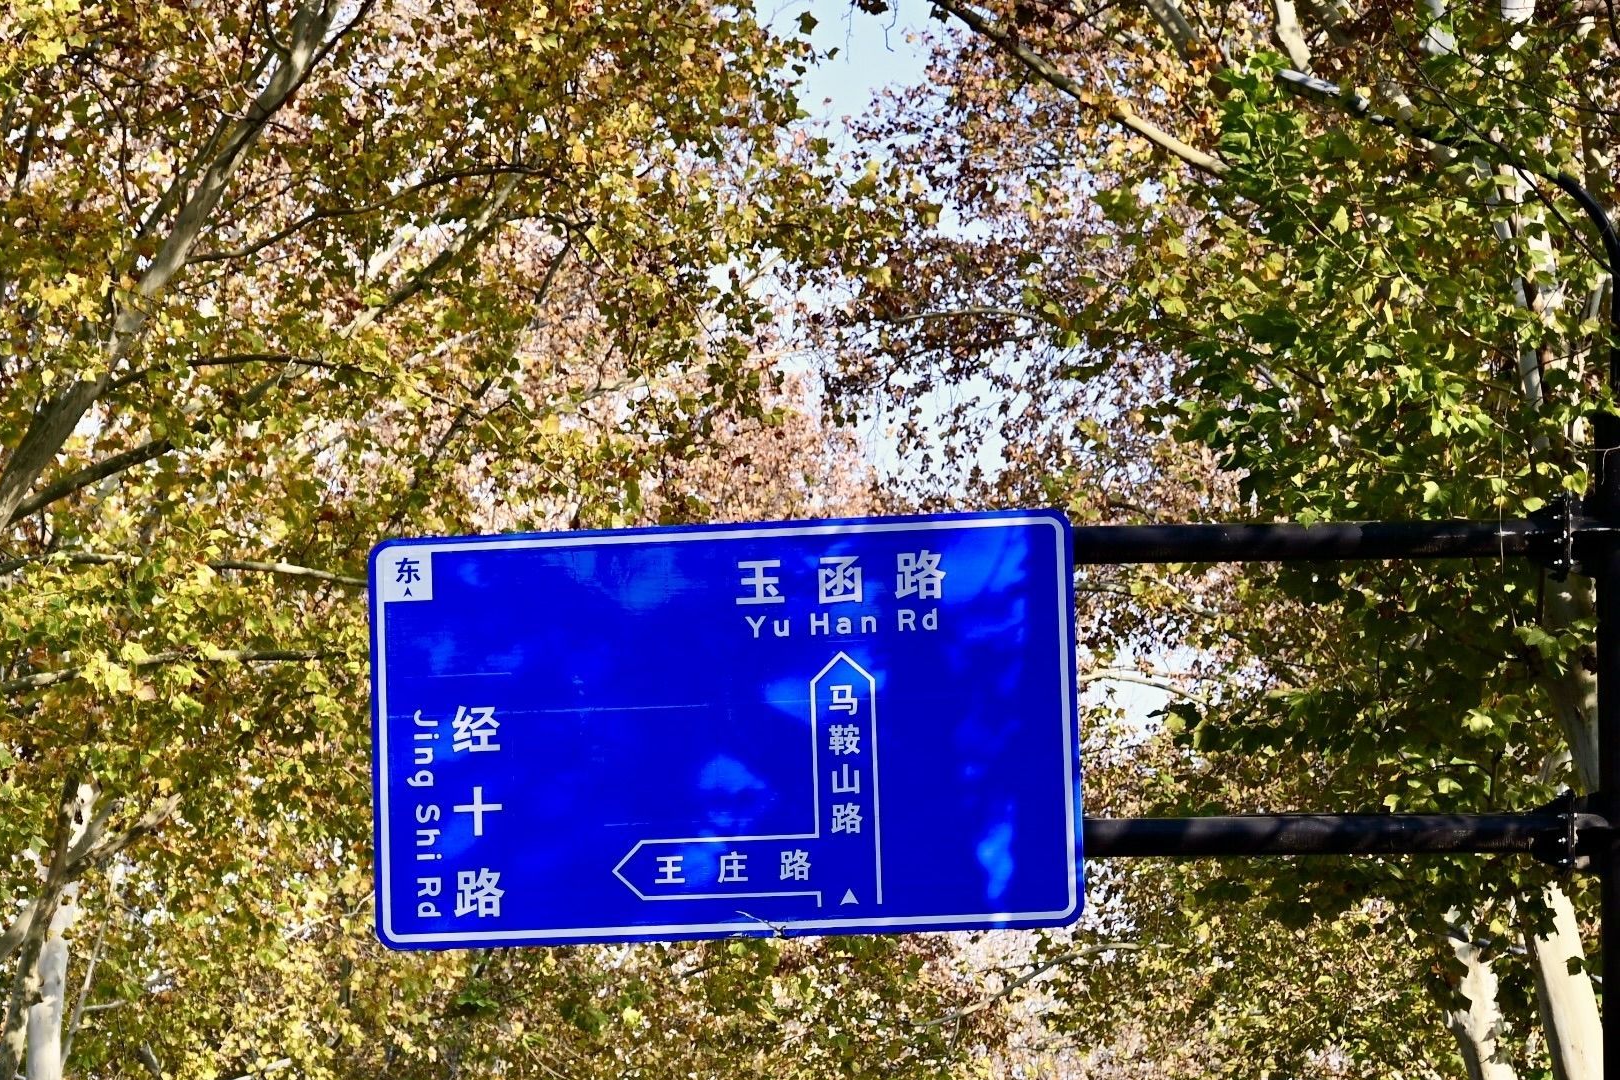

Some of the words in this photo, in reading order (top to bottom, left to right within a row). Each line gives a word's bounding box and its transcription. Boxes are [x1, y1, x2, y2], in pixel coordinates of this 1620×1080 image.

[394, 557, 421, 585] 东
[735, 549, 947, 607] 玉函路
[745, 614, 791, 639] Yu
[810, 611, 878, 635] Han
[898, 607, 939, 632] Rd
[406, 709, 440, 789] Jing
[828, 684, 863, 835] 马鞍山路
[415, 804, 442, 862] Shi
[451, 705, 506, 919] 经十路
[654, 848, 813, 886] 王庄路
[417, 877, 442, 919] Rd
